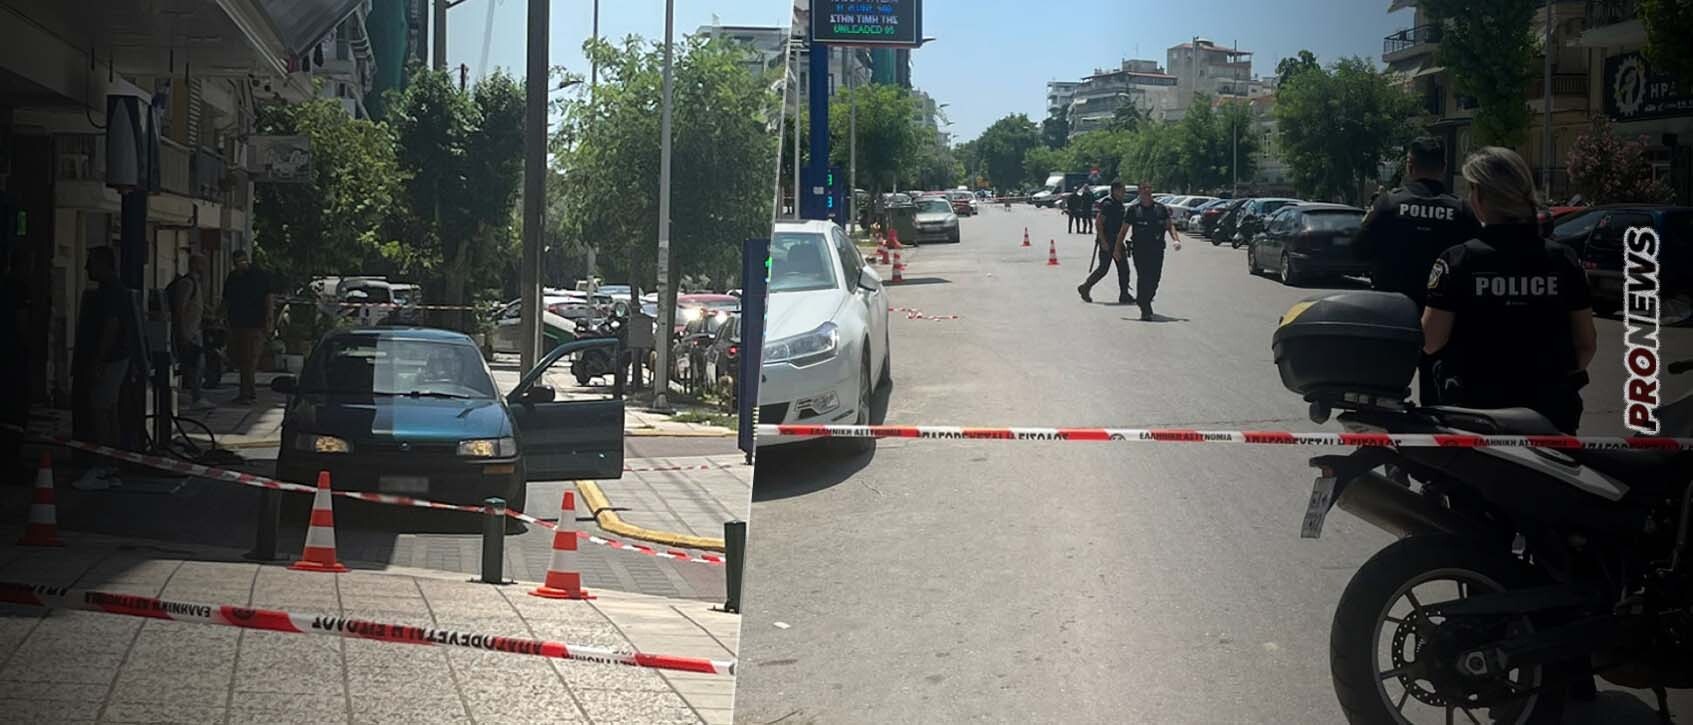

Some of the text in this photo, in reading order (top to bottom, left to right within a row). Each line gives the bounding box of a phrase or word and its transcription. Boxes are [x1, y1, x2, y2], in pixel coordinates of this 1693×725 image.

[830, 14, 898, 24] ΣΤΗΝ ΤΙΜΗ ΤΗΣ
[834, 25, 882, 34] UNLEADED
[1400, 203, 1454, 221] POLICE
[1475, 276, 1558, 296] POLICE
